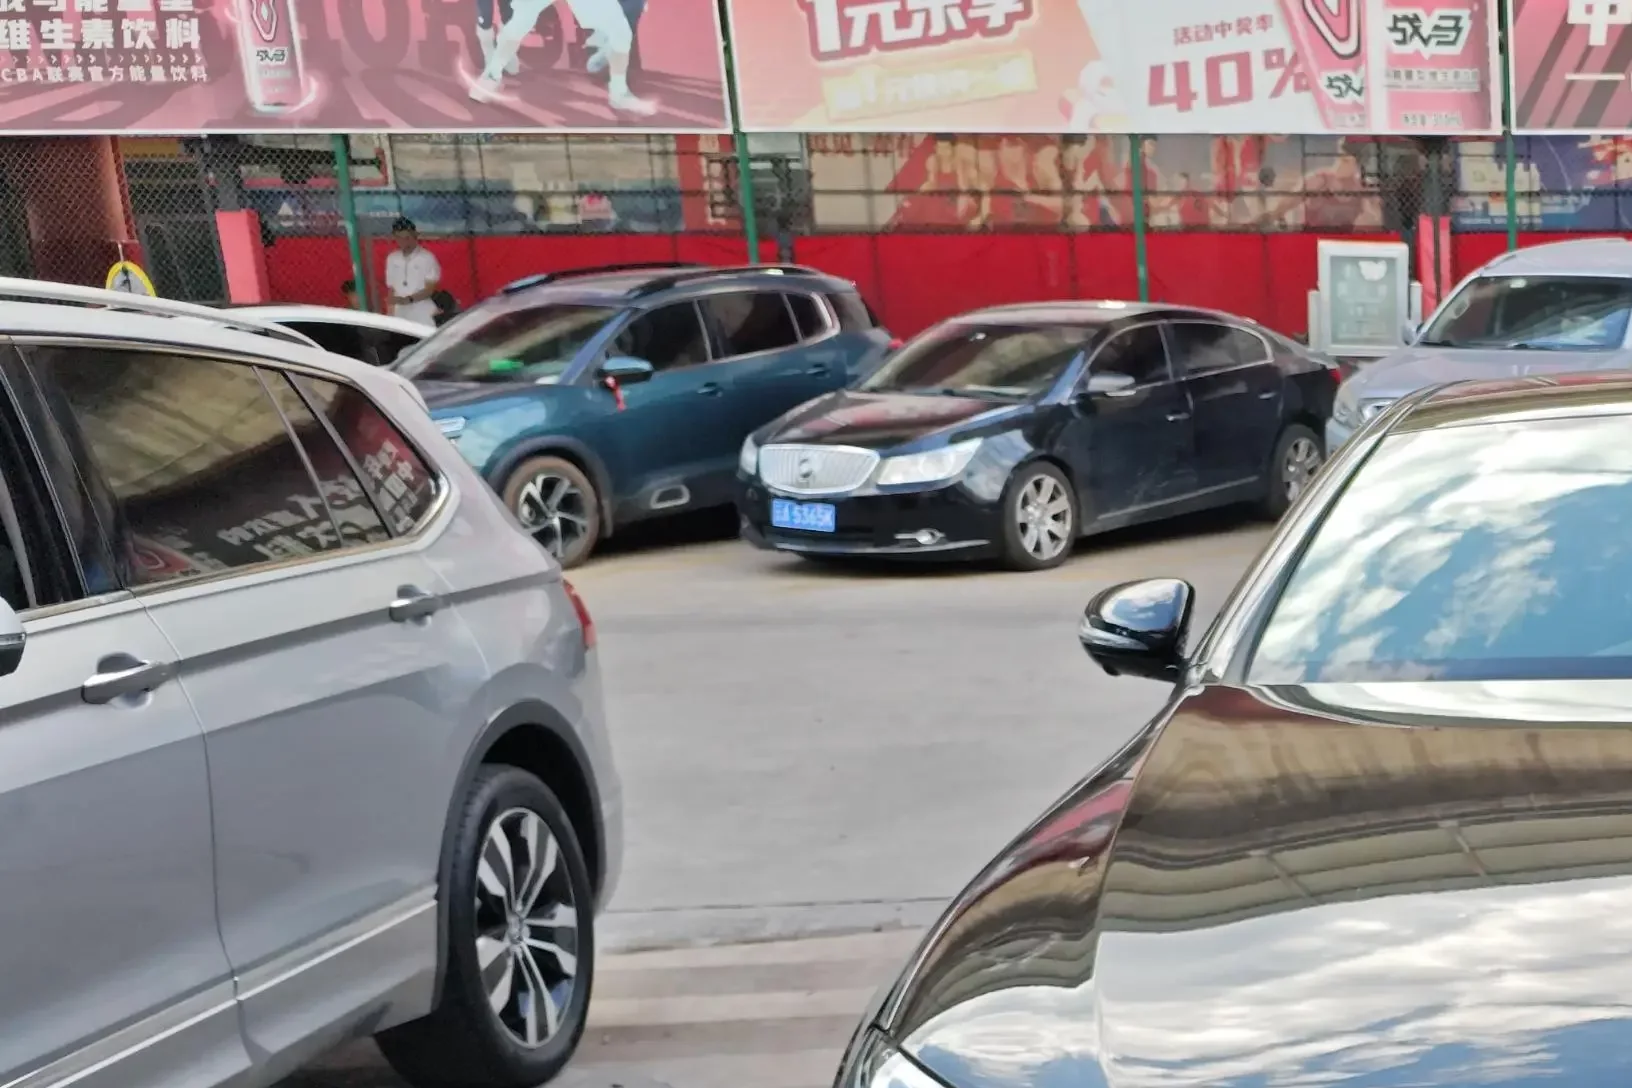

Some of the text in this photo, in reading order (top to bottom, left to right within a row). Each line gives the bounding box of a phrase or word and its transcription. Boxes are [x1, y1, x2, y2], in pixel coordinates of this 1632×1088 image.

[0, 18, 200, 49] 维生素饮料
[1149, 48, 1312, 112] 40%
